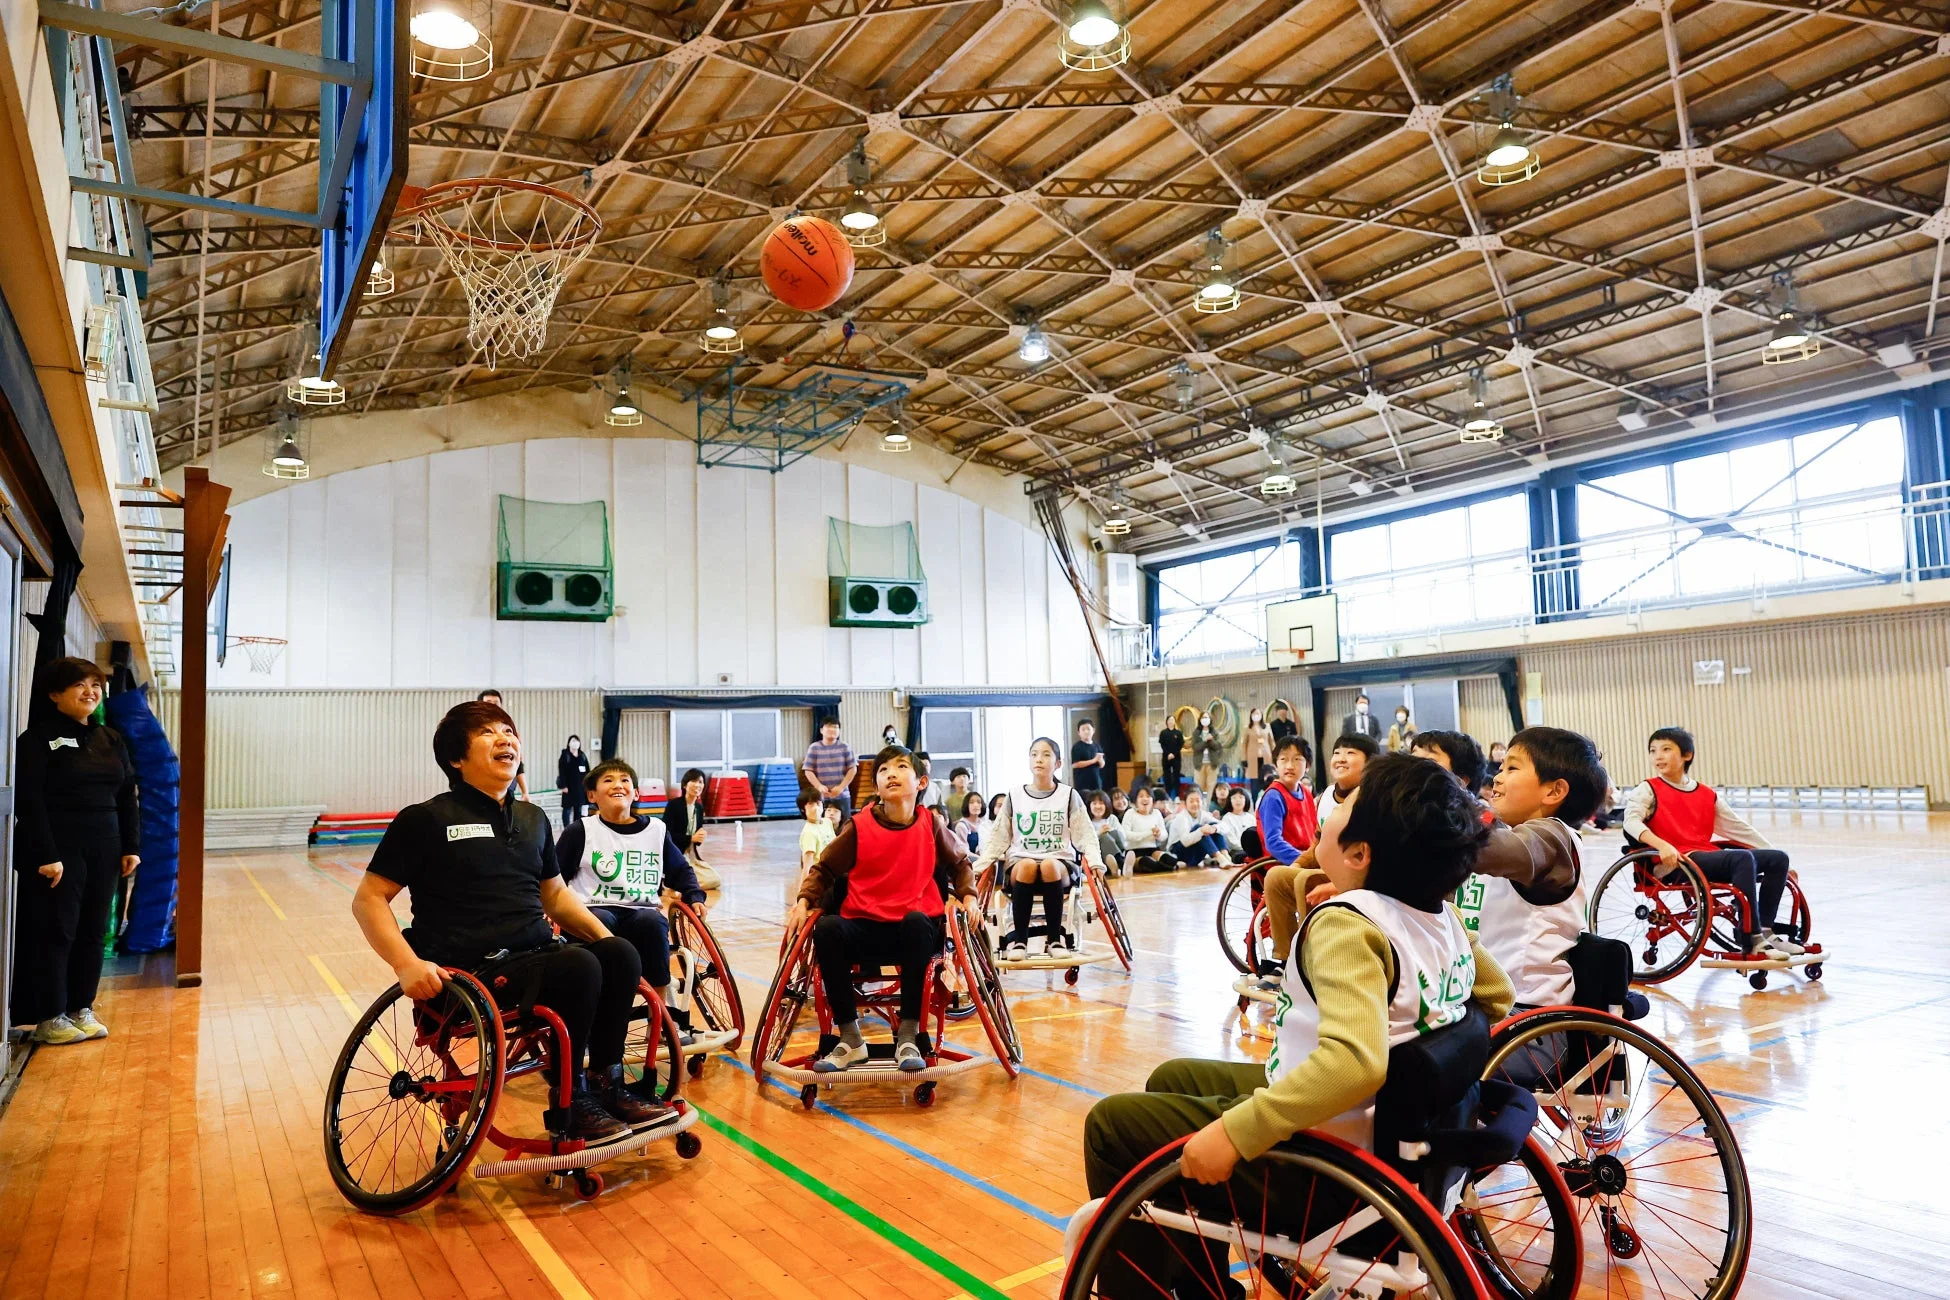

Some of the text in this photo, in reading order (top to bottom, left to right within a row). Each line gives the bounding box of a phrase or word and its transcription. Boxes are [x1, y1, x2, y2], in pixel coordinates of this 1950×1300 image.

[783, 222, 818, 256] molten
[1039, 810, 1065, 821] 日本
[1039, 824, 1064, 835] 財団
[1020, 837, 1065, 850] パラサポ
[626, 850, 660, 867] 日本
[626, 868, 659, 886] 財団
[592, 883, 658, 903] パラサポ
